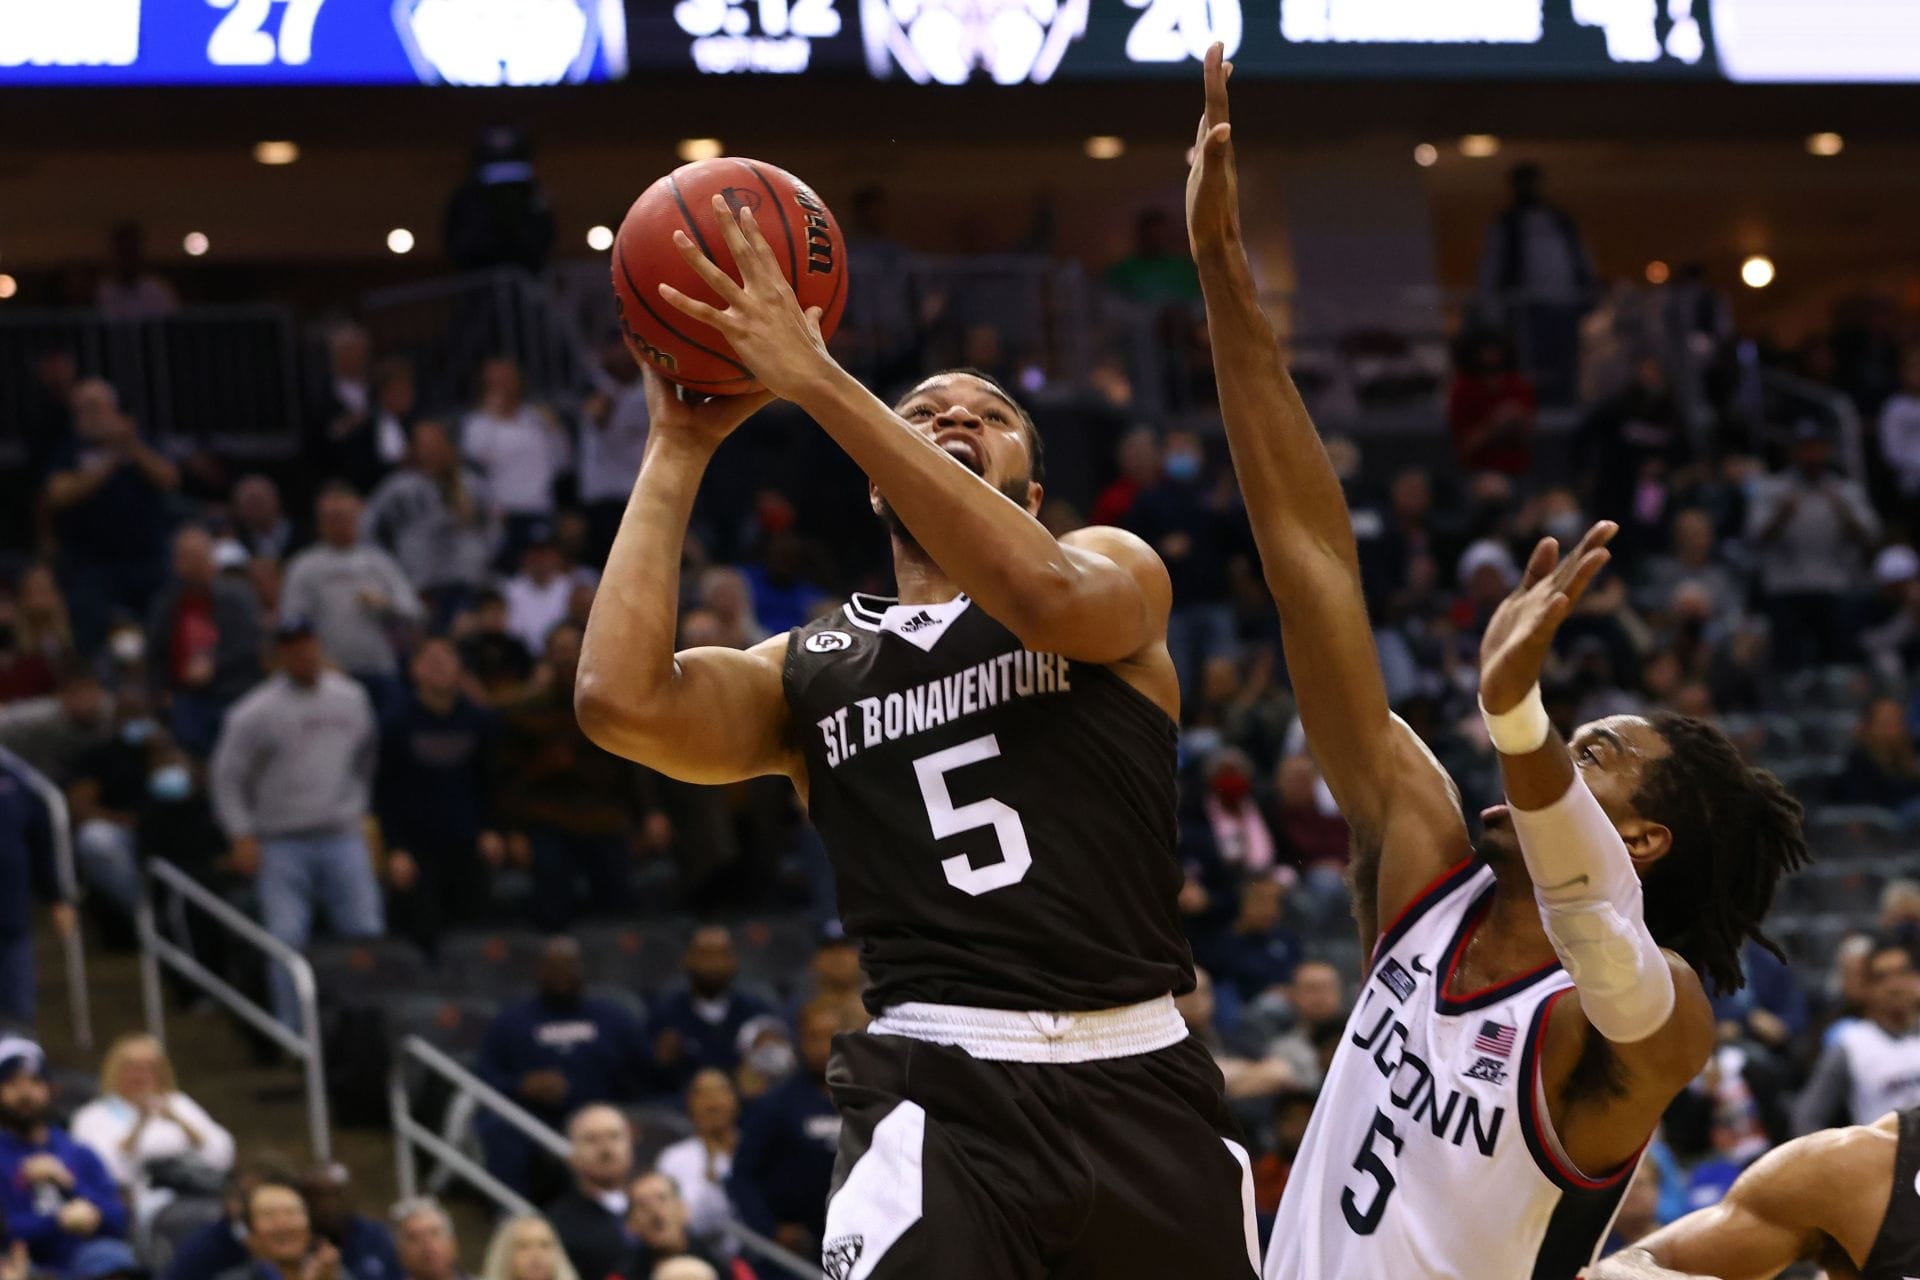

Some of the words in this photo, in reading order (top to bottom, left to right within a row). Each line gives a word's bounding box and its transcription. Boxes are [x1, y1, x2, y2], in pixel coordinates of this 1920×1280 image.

[816, 706, 857, 768] ST.
[854, 649, 1072, 749] BONAVENTURE
[912, 733, 1033, 897] 5
[1352, 988, 1505, 1158] UCONN
[1341, 1105, 1404, 1236] 5
